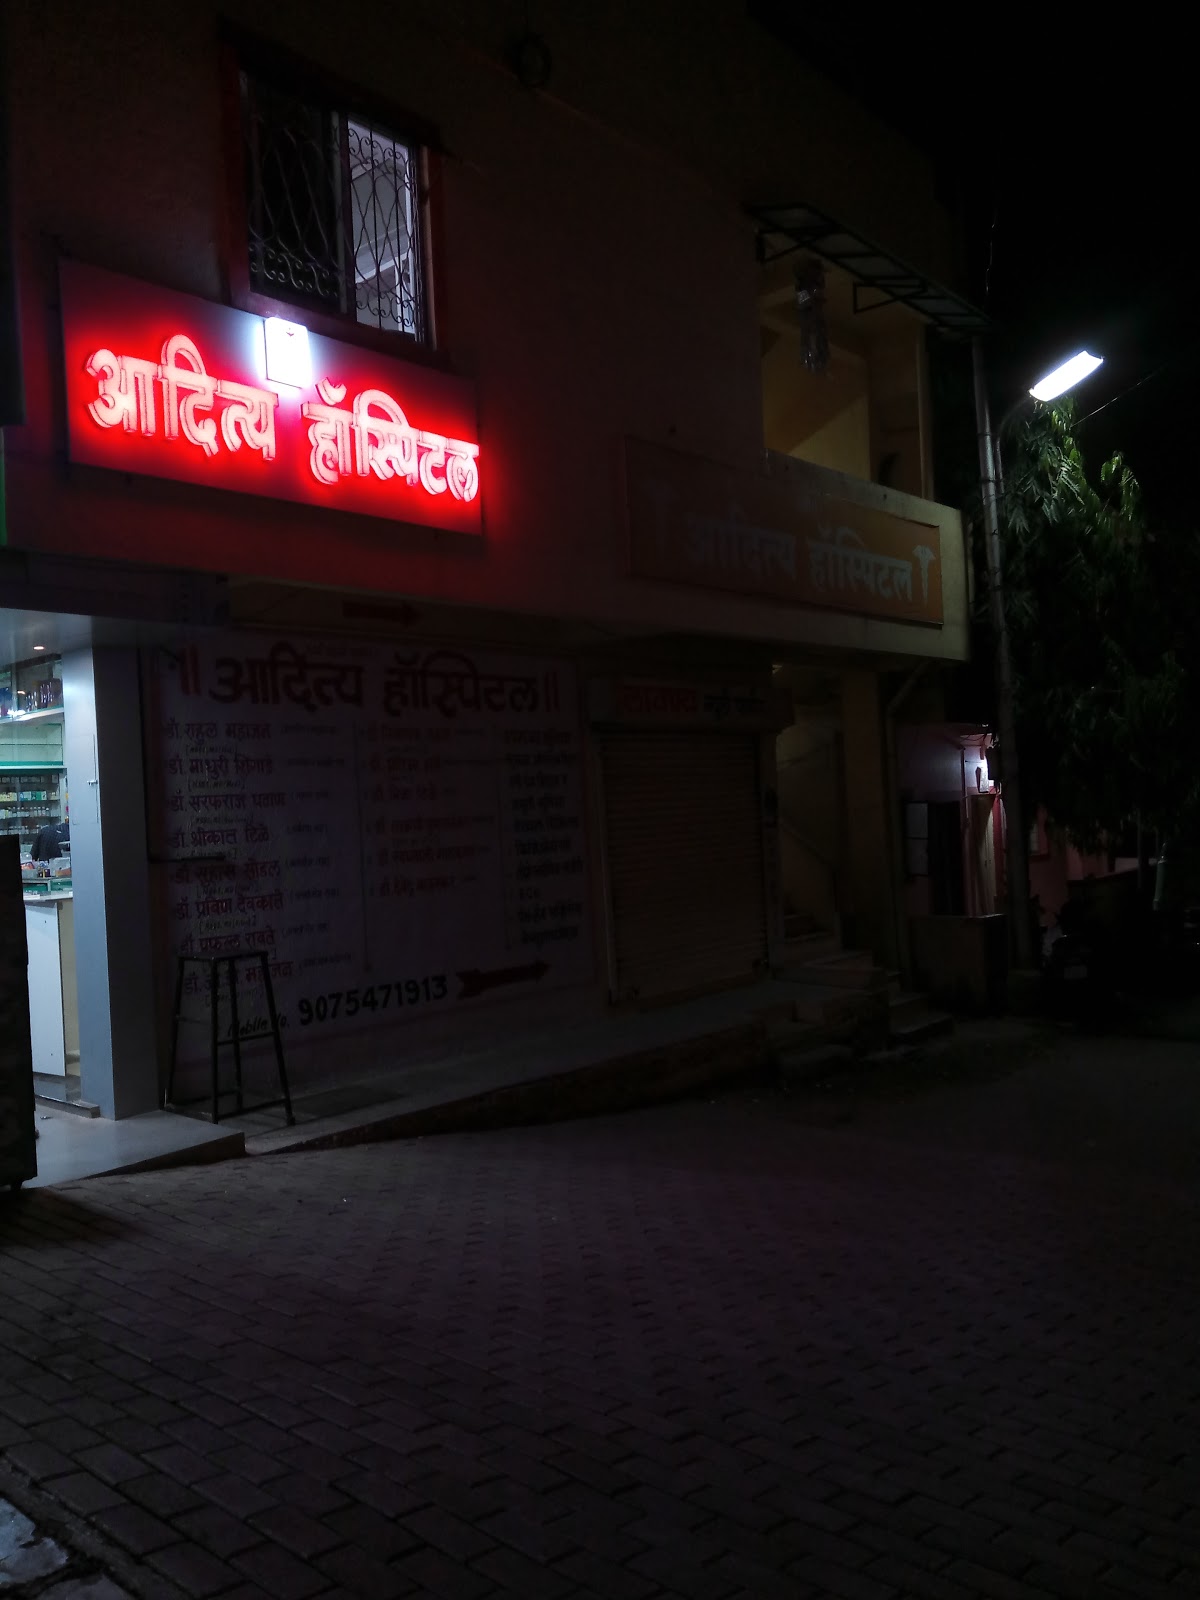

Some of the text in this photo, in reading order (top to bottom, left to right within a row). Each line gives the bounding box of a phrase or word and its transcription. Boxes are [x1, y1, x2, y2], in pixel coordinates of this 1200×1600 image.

[85, 333, 480, 502] आदित्य हॉस्पिटल
[681, 502, 914, 601] आदित्य हॉस्पिटल
[208, 642, 364, 712] आदित्य
[384, 651, 539, 718] हॉस्पिटल
[299, 975, 448, 1025] 9075471913
